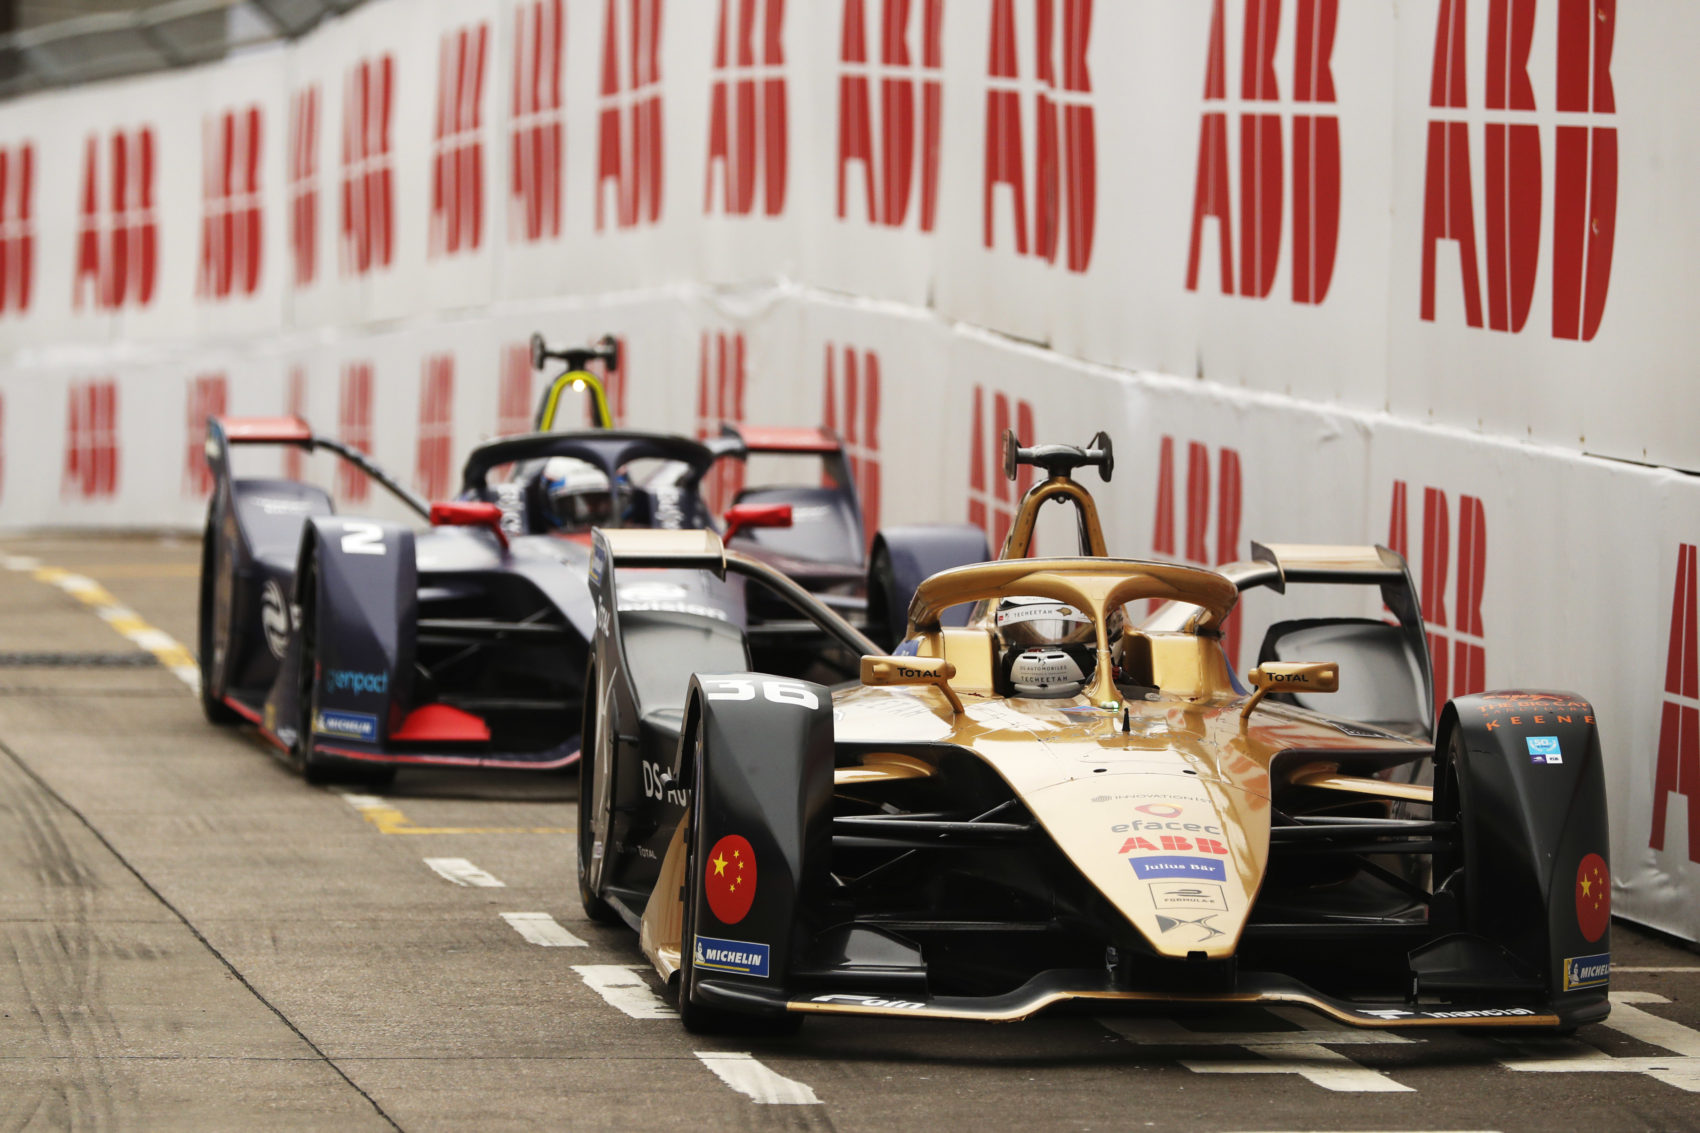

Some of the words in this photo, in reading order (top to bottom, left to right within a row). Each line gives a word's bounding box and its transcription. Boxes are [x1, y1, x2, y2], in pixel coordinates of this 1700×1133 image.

[705, 0, 788, 218] ABB
[836, 0, 943, 234] ABB
[982, 0, 1098, 274] ABB
[1185, 0, 1342, 306] ABB
[1420, 0, 1619, 342] ABB
[1014, 609, 1053, 618] TECHEETAH
[897, 667, 942, 678] TOTAL
[1266, 672, 1309, 682] TOTAL
[708, 679, 819, 710] 36
[1485, 715, 1596, 732] KEENE
[643, 760, 663, 801] DS
[1111, 820, 1221, 836] efacec
[1118, 835, 1229, 855] ABB
[1144, 862, 1185, 872] Julius
[1190, 863, 1216, 873] Bär
[706, 948, 762, 967] MICHELIN
[1580, 963, 1610, 979] MICHEL
